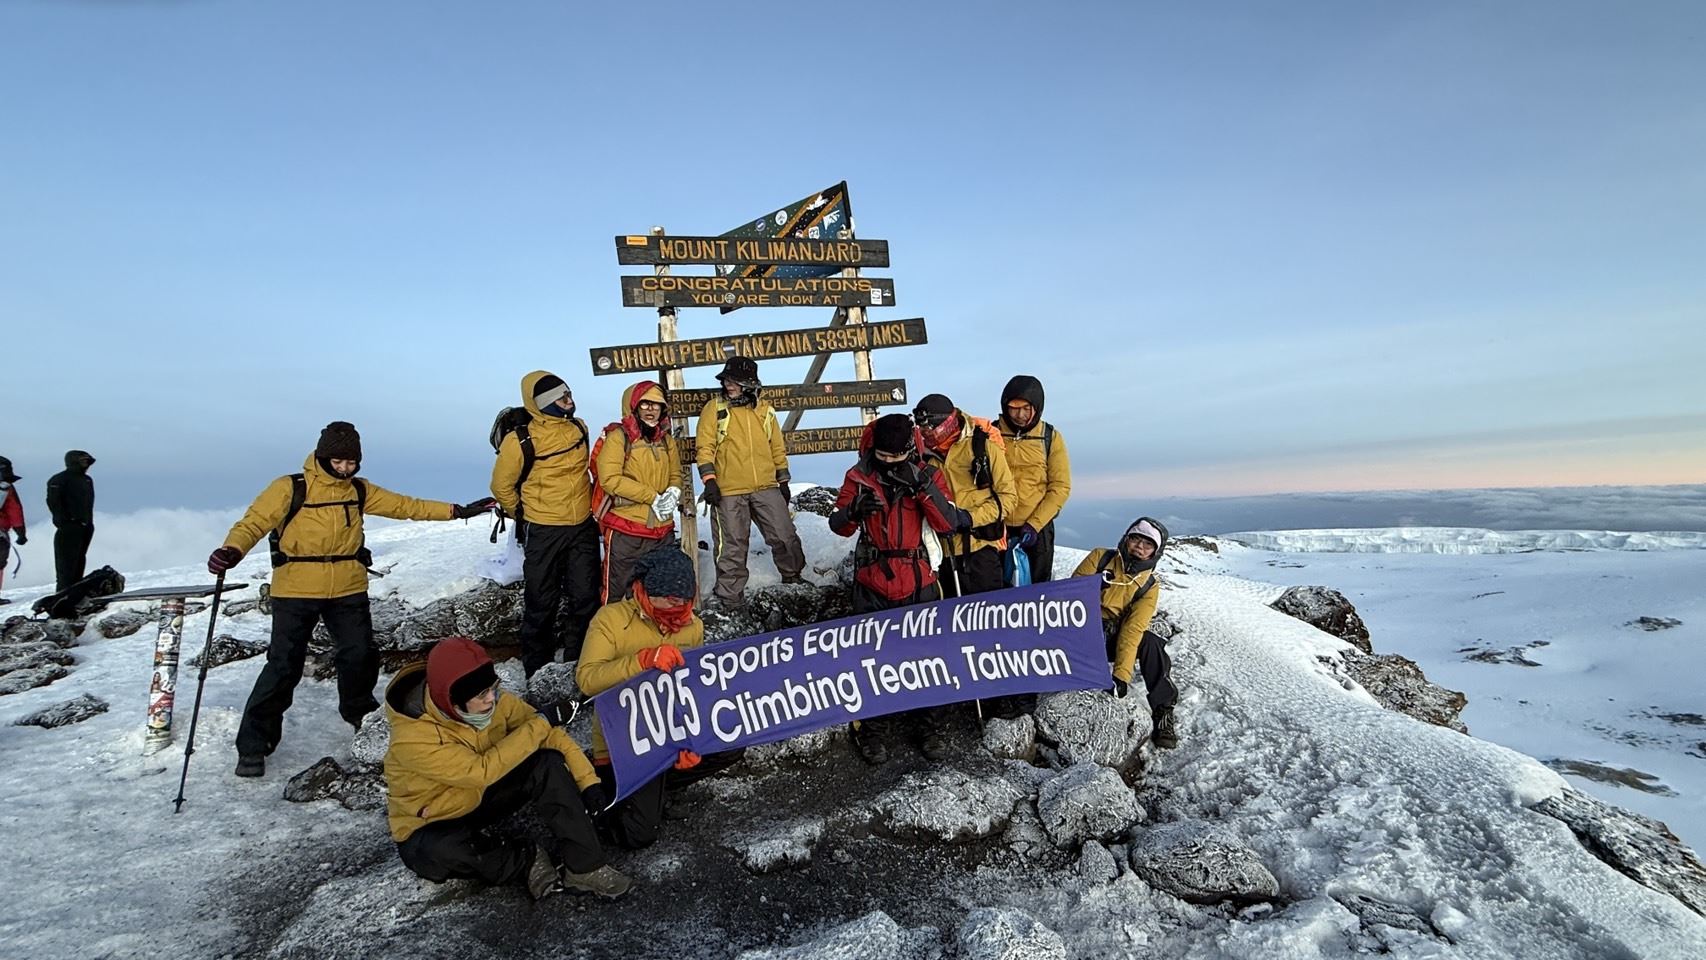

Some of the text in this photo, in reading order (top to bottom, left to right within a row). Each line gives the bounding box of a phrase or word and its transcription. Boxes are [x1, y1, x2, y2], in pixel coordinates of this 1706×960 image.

[660, 239, 862, 262] MOUNT KILIMANJARO
[641, 277, 873, 292] CONGRATULATIONS
[691, 294, 841, 305] YOU ARE NOW AT
[613, 345, 676, 370] UHURU
[679, 340, 728, 364] PEAK
[815, 327, 868, 351] 5895M
[873, 323, 913, 346] AMSL
[767, 398, 787, 408] REE
[789, 395, 840, 408] STANDING
[843, 393, 892, 404] MOUNTAIN
[785, 431, 814, 442] GEST
[817, 427, 865, 441] VOLCANO
[699, 594, 1087, 691] Sports Equity-Mt. Kilimanjaro
[711, 643, 1072, 743] Climbing Team, Taiwan
[619, 668, 700, 756] 2025
